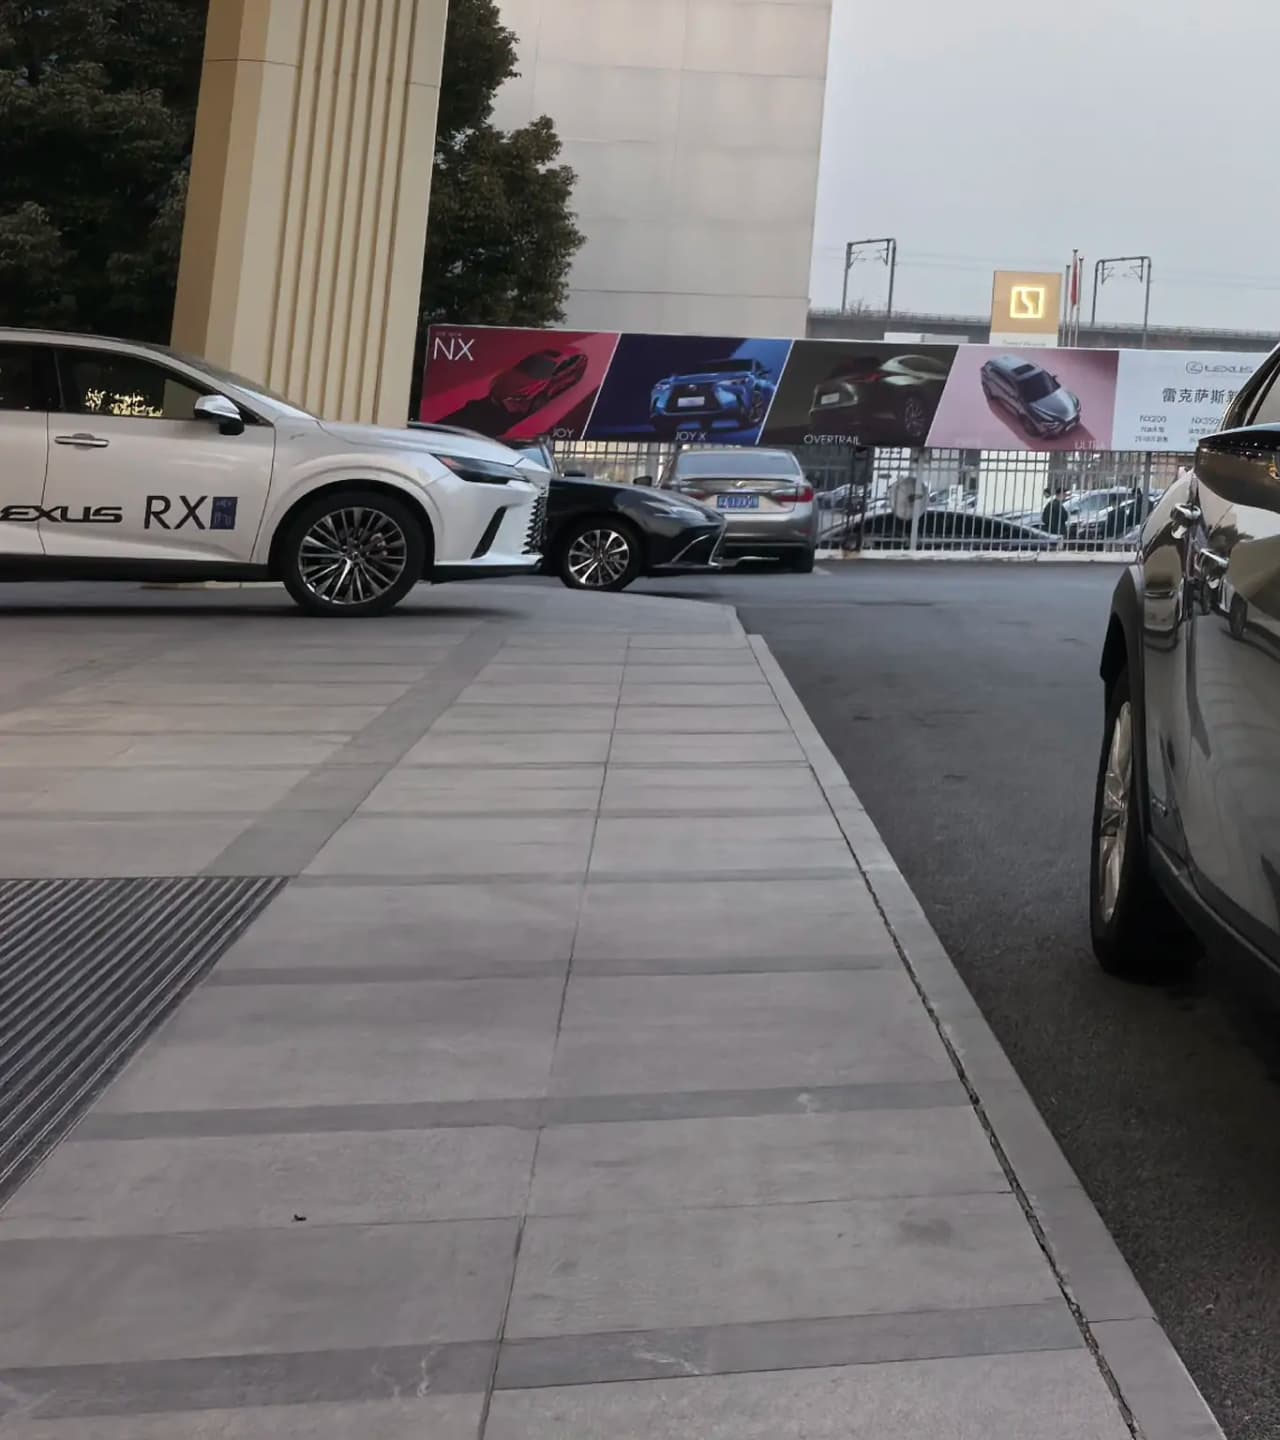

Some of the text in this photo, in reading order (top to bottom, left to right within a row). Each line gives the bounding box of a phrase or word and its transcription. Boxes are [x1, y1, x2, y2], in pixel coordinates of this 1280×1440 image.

[433, 337, 475, 361] NX
[552, 428, 575, 438] JOY
[675, 431, 707, 441] JOY X
[804, 433, 861, 445] OVERTRAIL
[144, 495, 208, 530] RX
